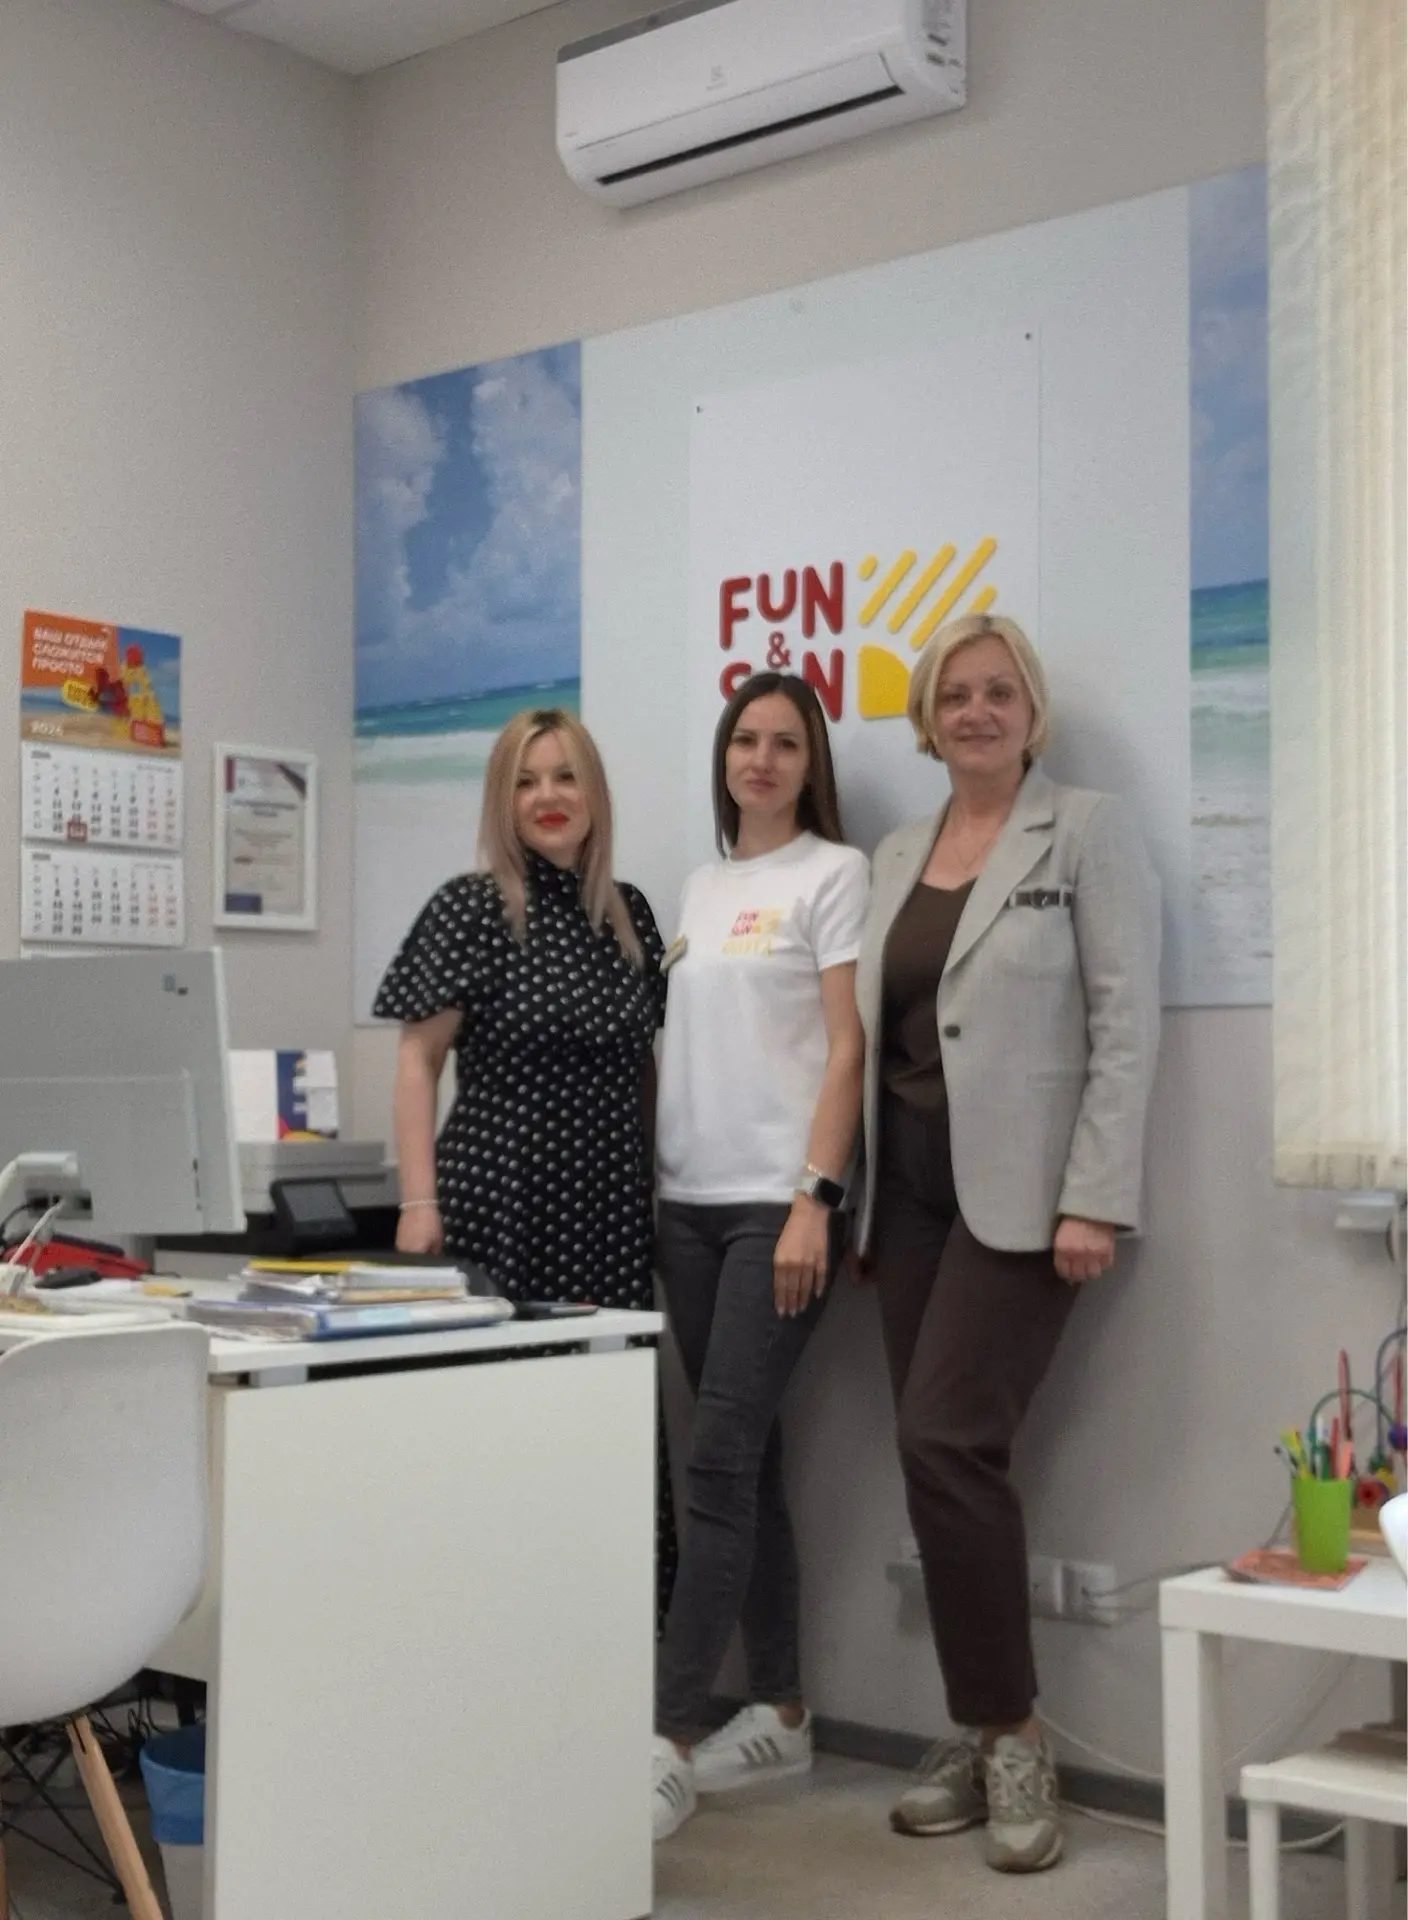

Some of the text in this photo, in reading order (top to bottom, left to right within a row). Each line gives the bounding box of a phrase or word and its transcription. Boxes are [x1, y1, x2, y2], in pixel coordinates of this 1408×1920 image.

[719, 560, 844, 650] FUN
[719, 648, 844, 722] SN
[766, 631, 791, 670] &
